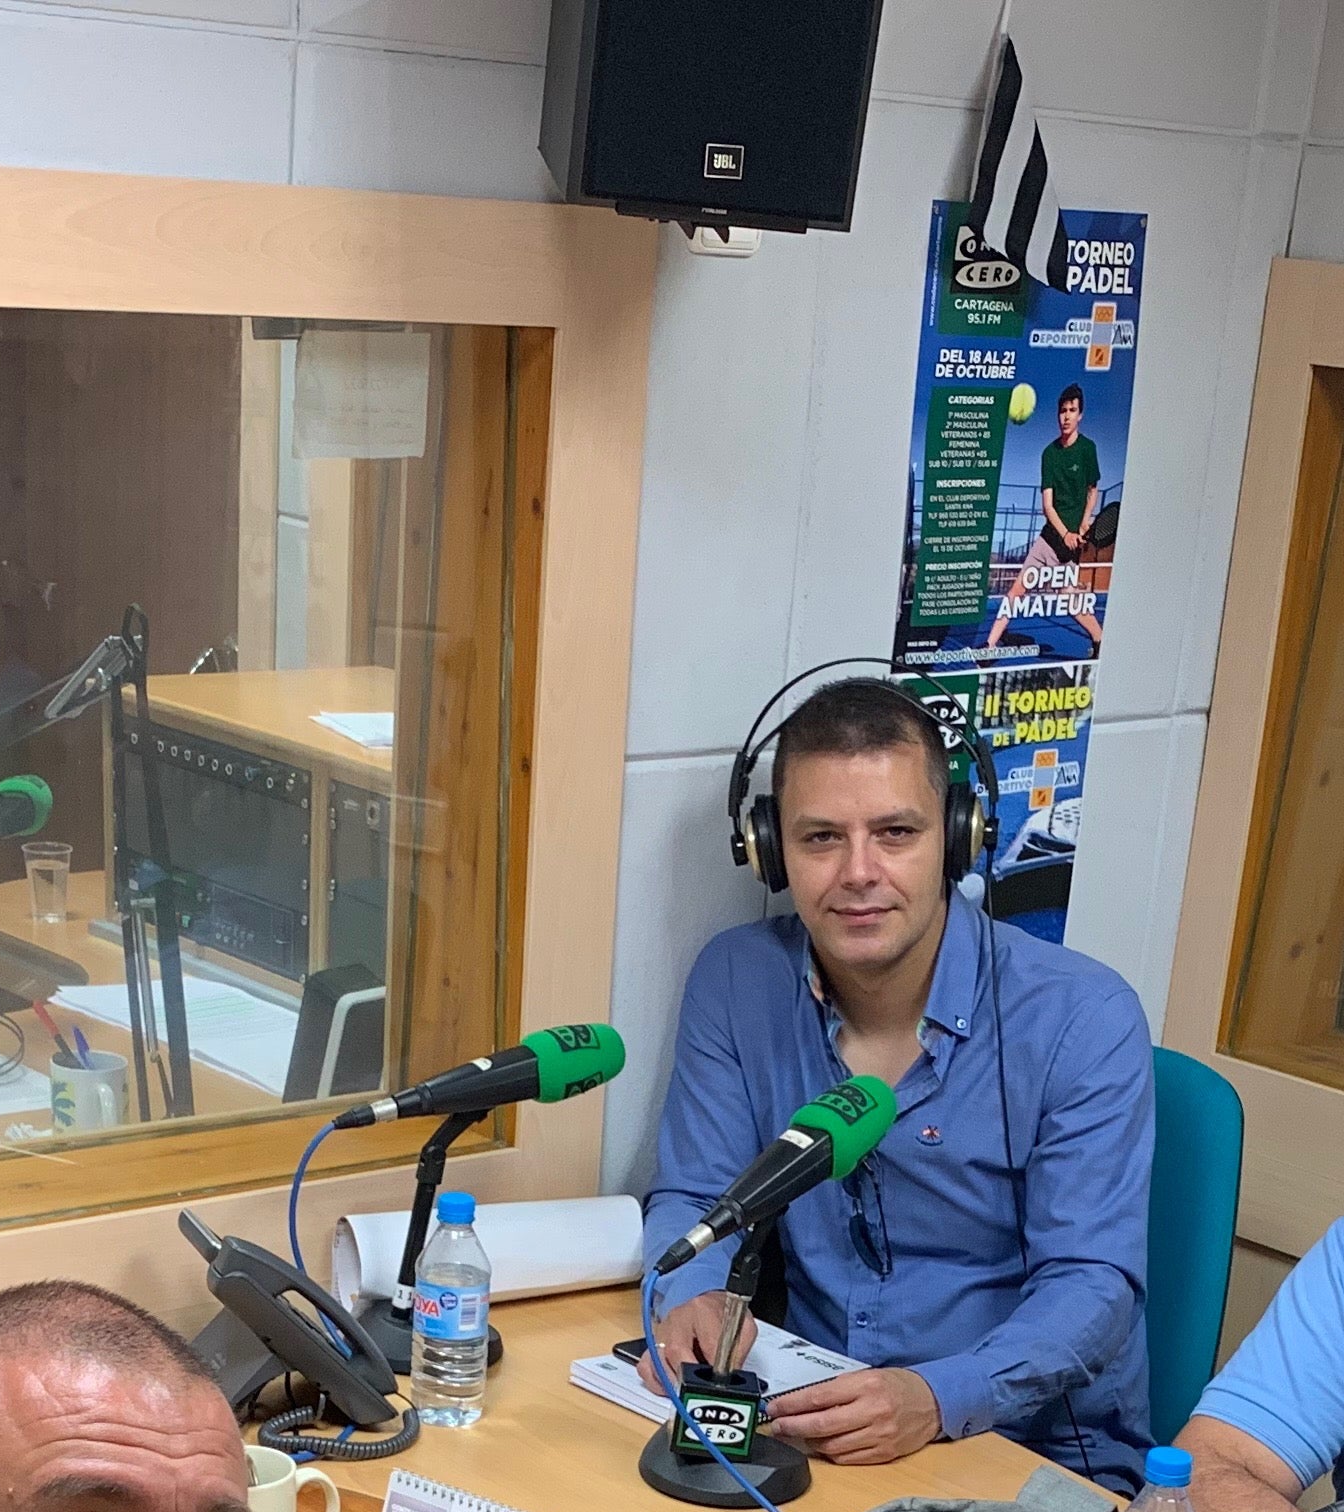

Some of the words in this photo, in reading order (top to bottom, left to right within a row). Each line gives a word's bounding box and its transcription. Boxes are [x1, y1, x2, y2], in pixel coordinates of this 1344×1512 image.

[713, 153, 736, 169] JBL
[1067, 240, 1134, 266] TORNEO
[966, 266, 1013, 283] CERO
[954, 299, 1015, 312] CARTAGENA
[967, 313, 986, 324] 95.1
[987, 314, 1001, 325] FM
[1032, 333, 1091, 344] DEPORTIVO
[940, 349, 966, 363] DEL
[969, 351, 981, 364] 18
[983, 351, 999, 364] AL
[1002, 351, 1015, 364] 21
[935, 364, 953, 377] DE
[956, 365, 1015, 379] OCTUBRE
[1022, 566, 1080, 590] OPEN
[997, 593, 1097, 619] AMATEUR
[1008, 686, 1091, 715] TORNEO
[992, 732, 1010, 747] DE
[694, 1407, 740, 1423] ONDA
[705, 1428, 737, 1440] ERO
